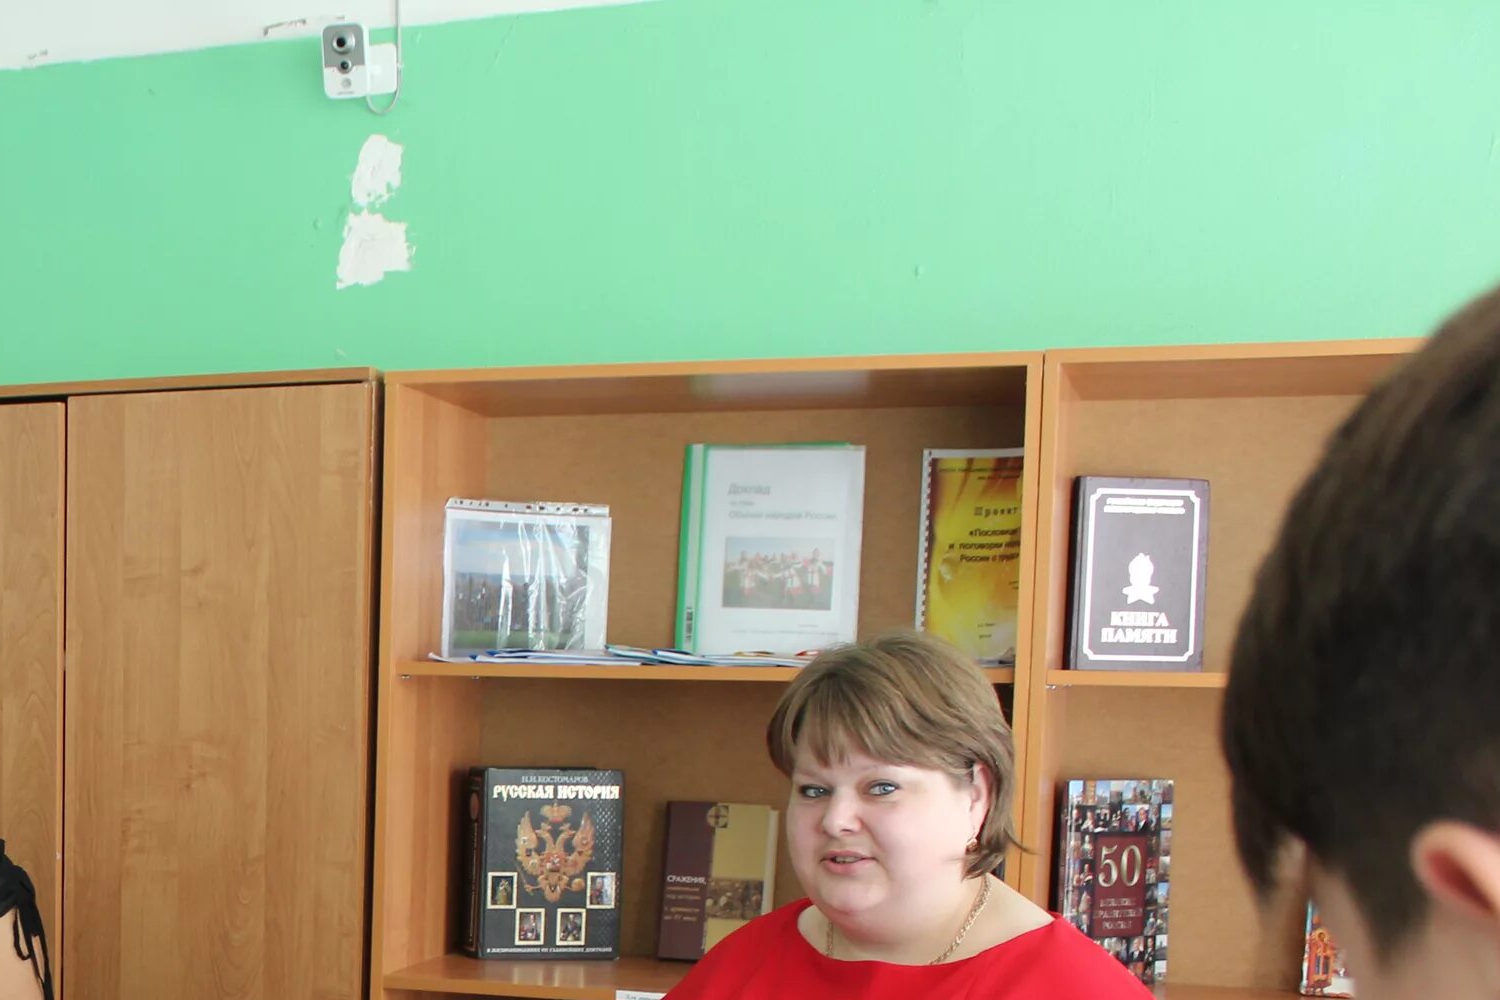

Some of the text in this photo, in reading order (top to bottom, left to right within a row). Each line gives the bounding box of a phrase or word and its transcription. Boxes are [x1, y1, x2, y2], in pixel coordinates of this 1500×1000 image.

[1109, 611, 1170, 627] КНИГА
[1100, 627, 1178, 644] ПАМЯТИ
[492, 784, 621, 802] РУССКАЯ ИСТОРИЯ
[1098, 844, 1143, 888] 50
